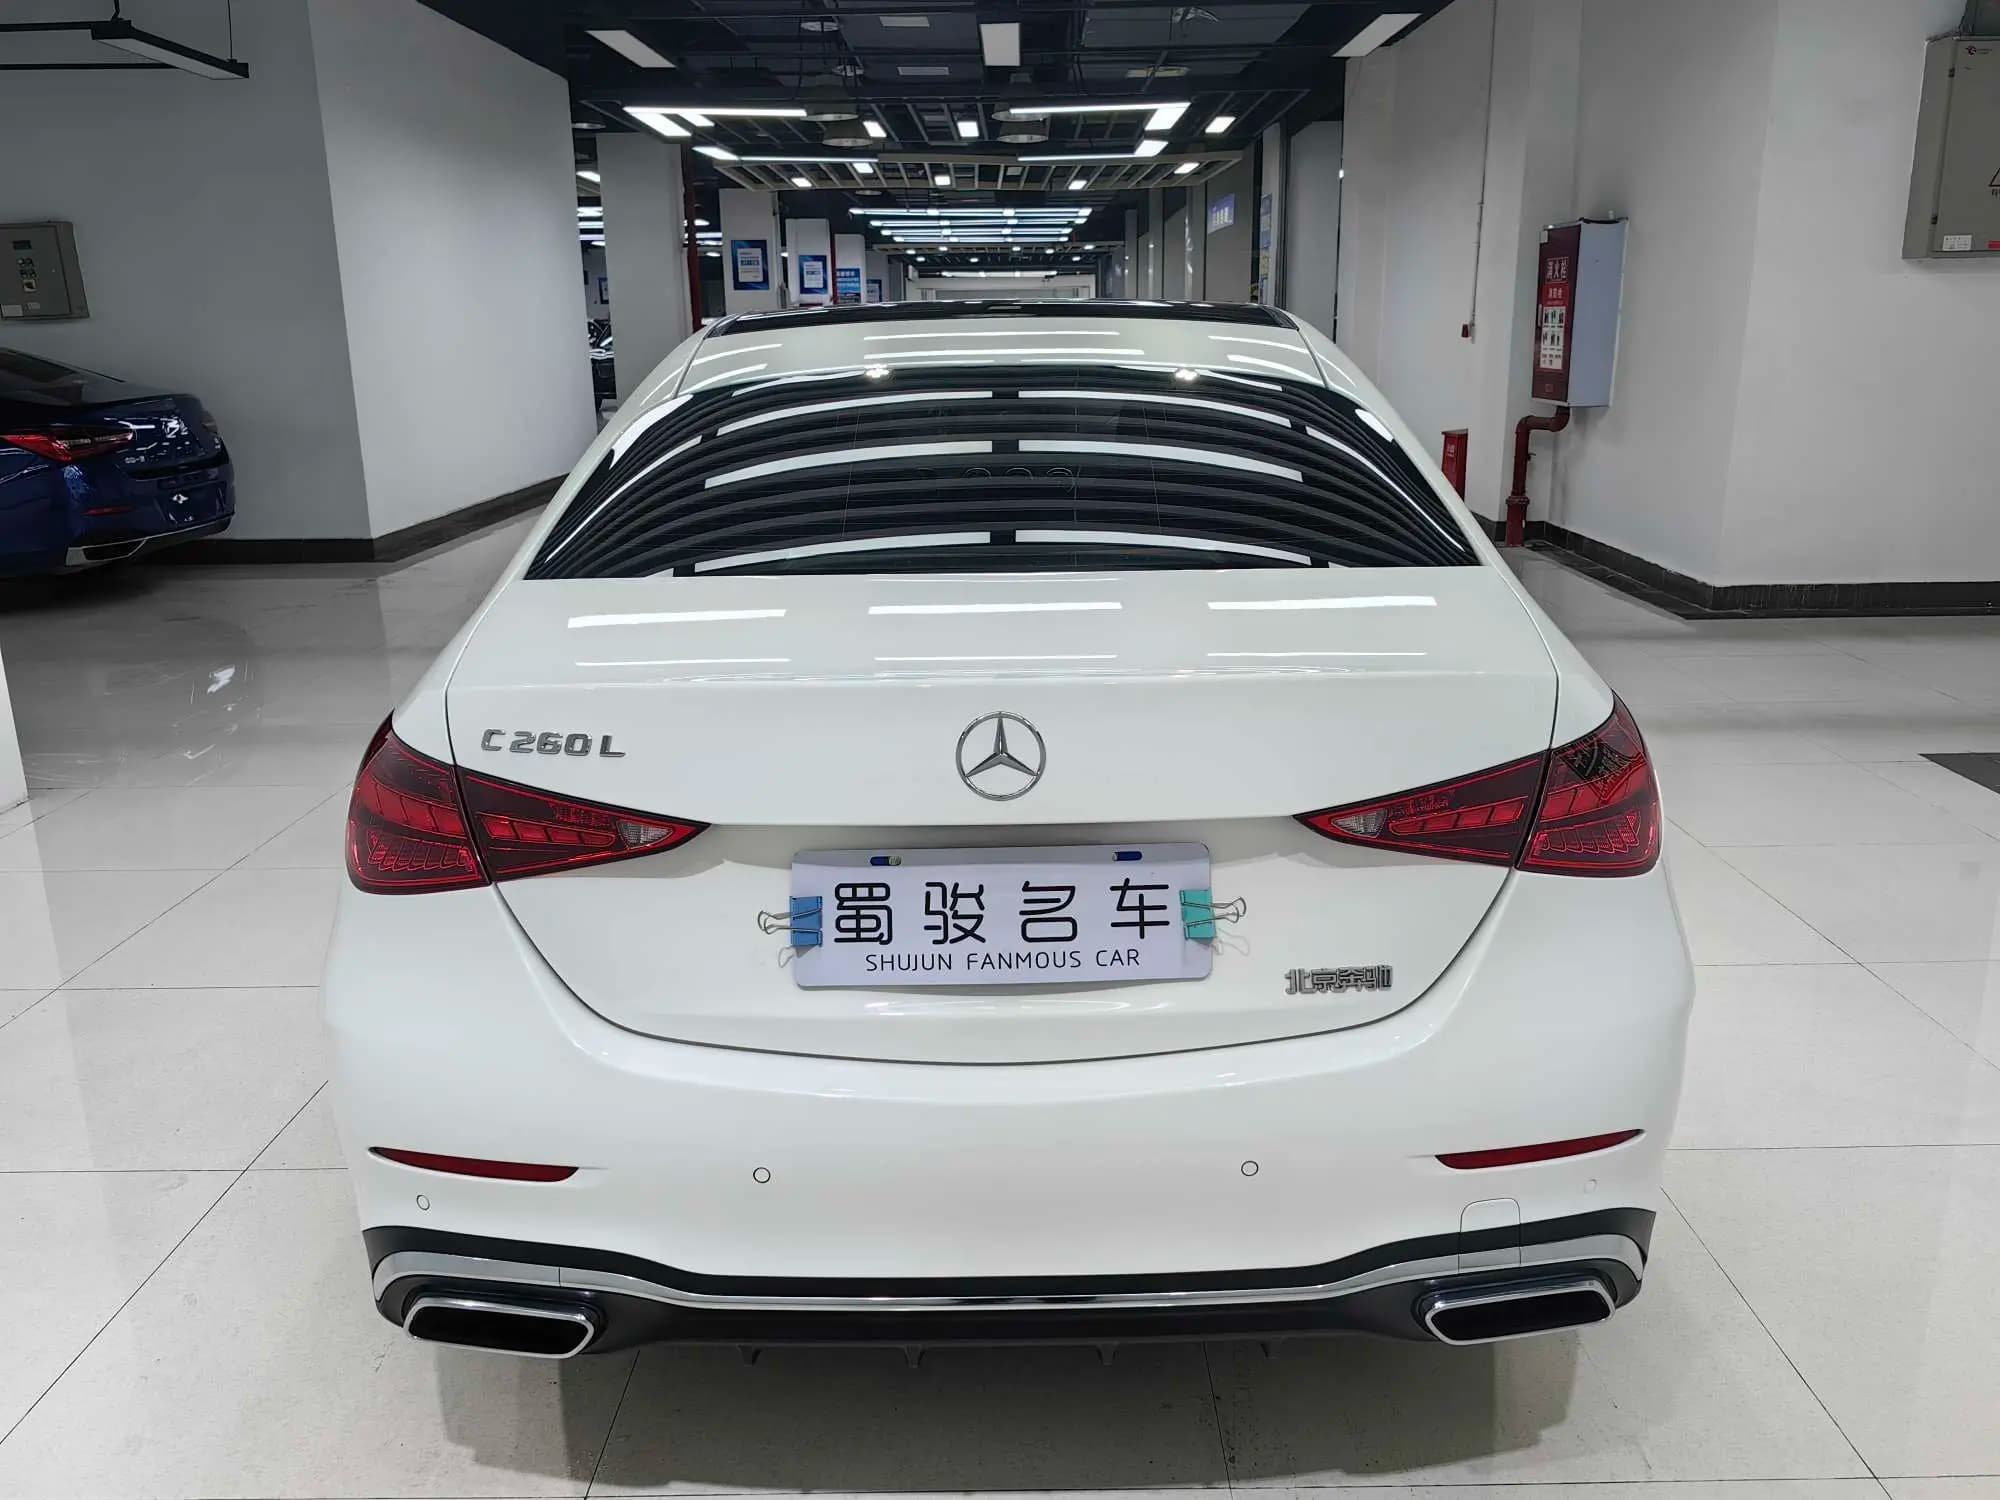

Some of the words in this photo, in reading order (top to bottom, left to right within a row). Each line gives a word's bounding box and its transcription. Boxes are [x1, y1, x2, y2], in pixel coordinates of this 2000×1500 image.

[834, 878, 1170, 945] 蜀骏名车
[865, 953, 952, 972] SHUJUN
[967, 951, 1082, 970] FANMOUS
[1096, 949, 1141, 967] CAR
[1284, 965, 1393, 994] 北京奔驰
